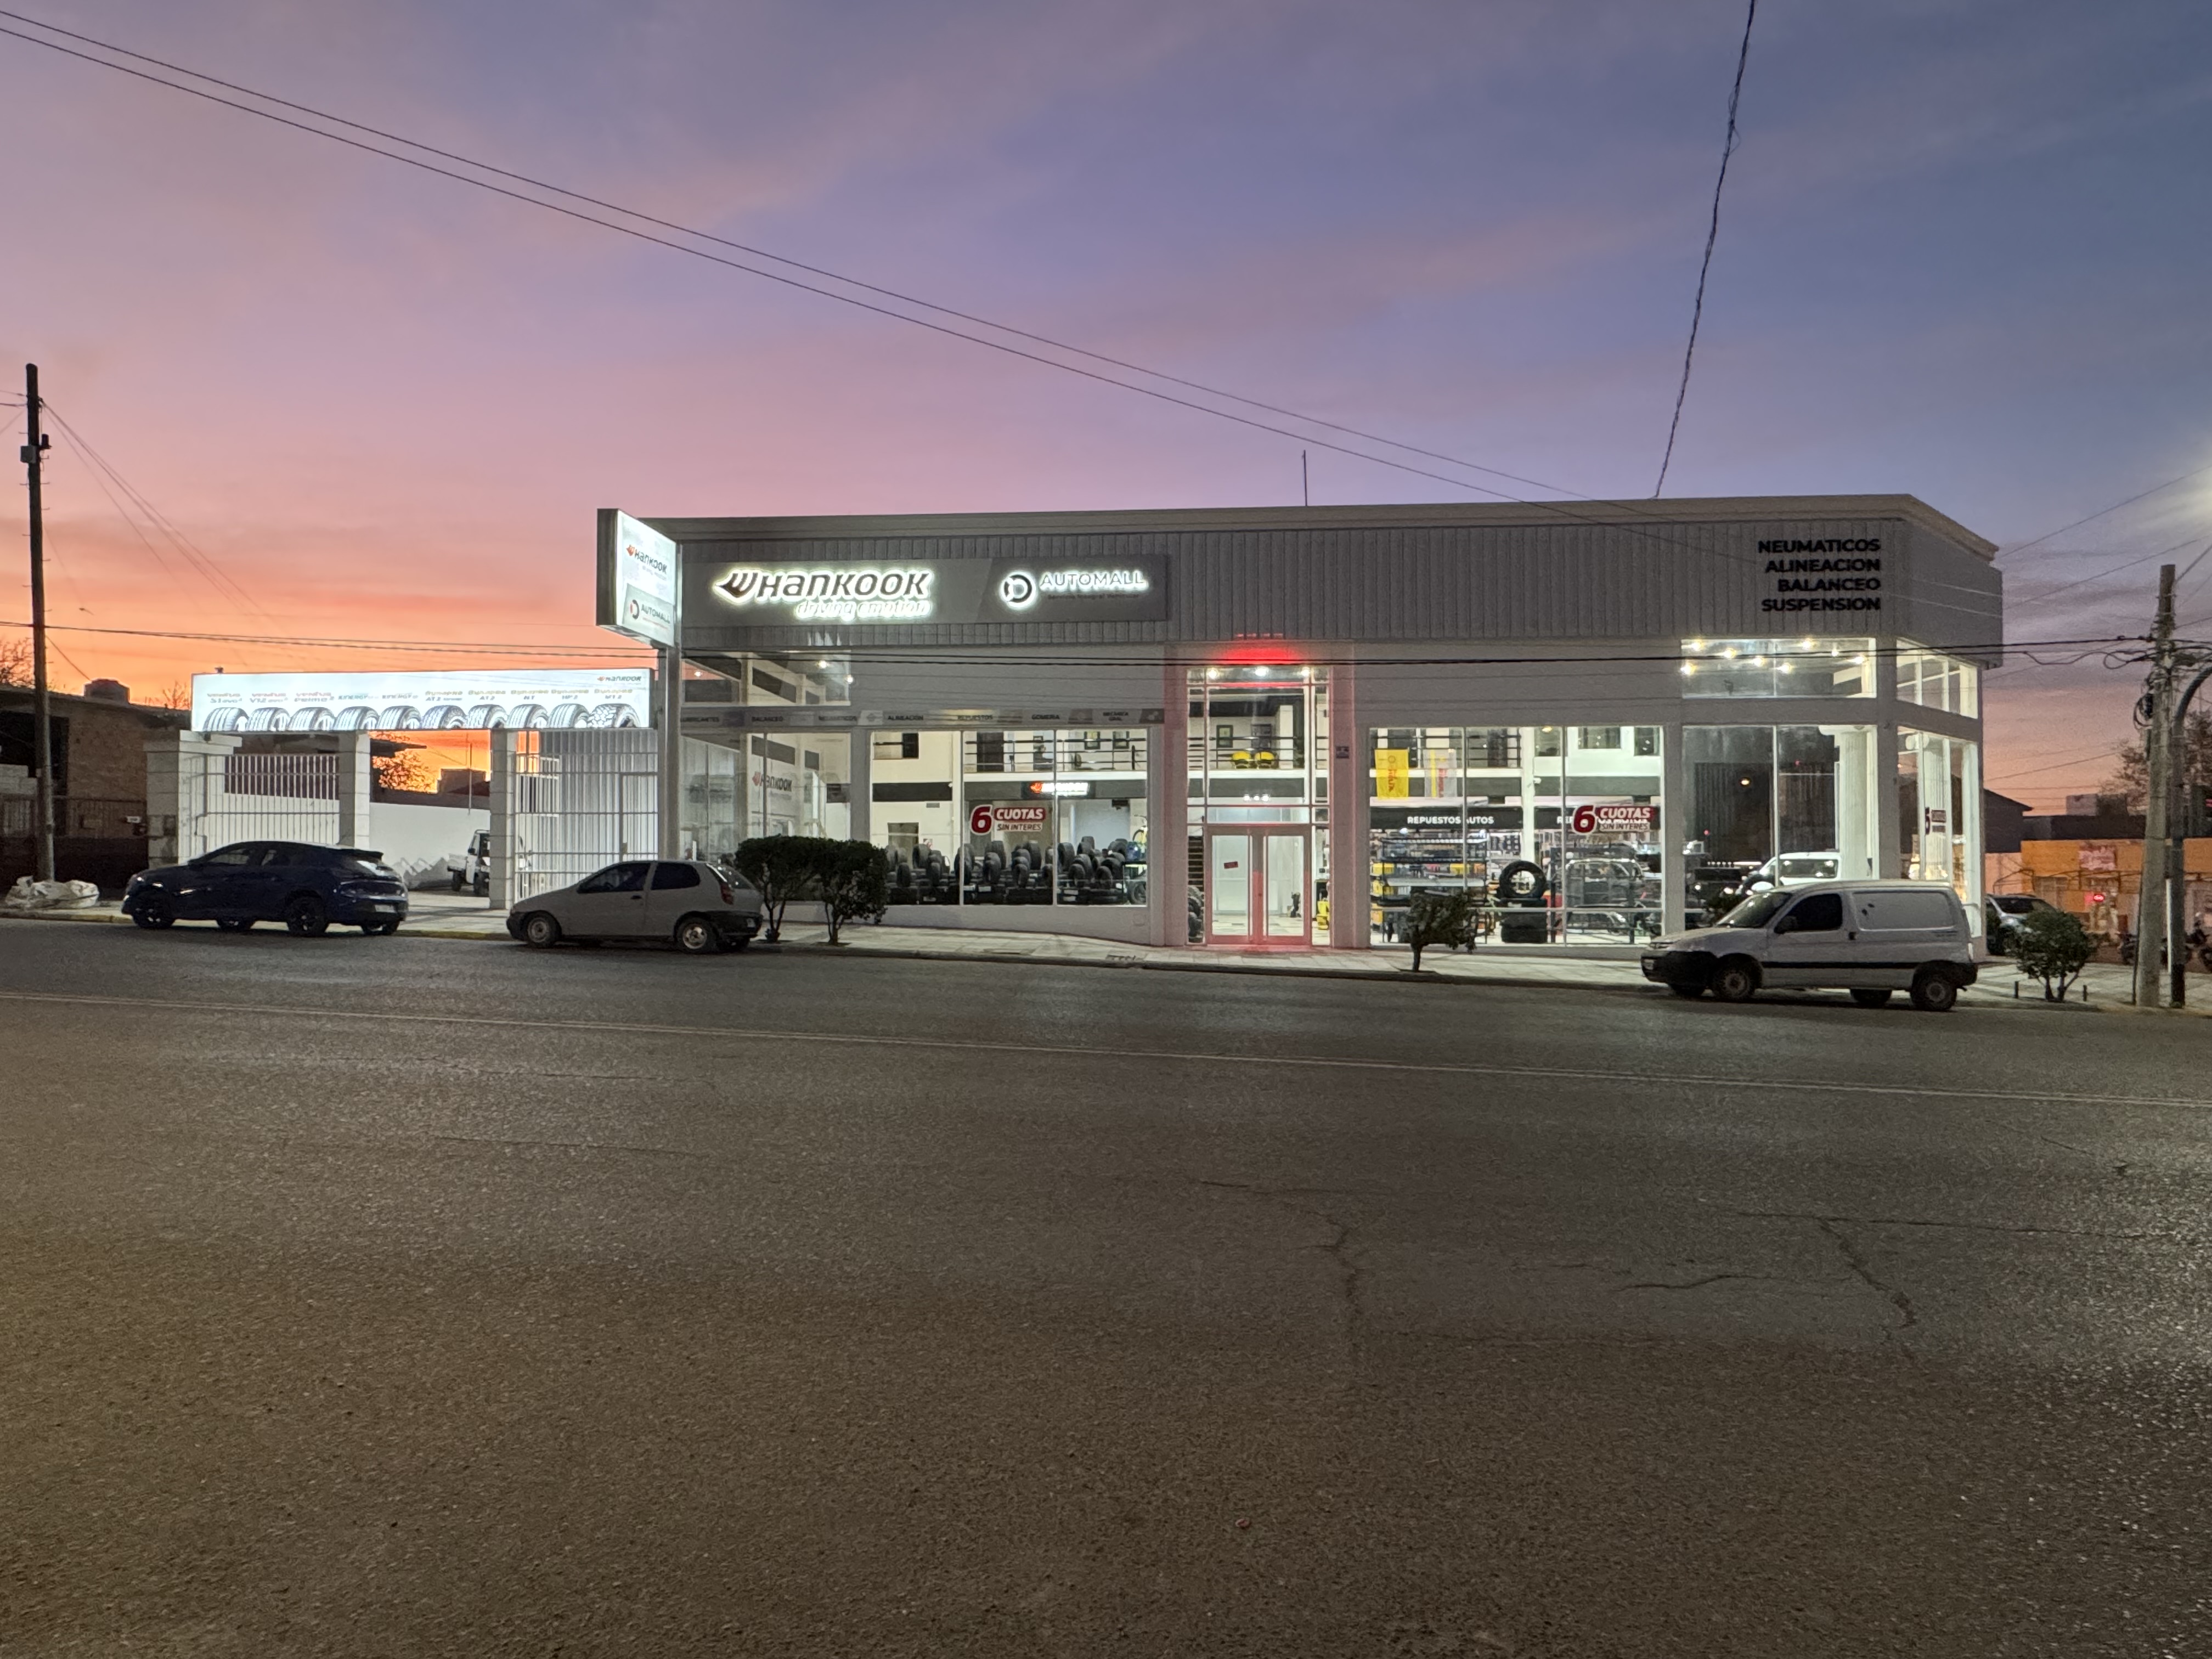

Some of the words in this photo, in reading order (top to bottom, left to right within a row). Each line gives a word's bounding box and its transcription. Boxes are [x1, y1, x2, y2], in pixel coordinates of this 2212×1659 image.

[1758, 539, 1881, 553] NEUMATICOS
[1765, 558, 1881, 573] ALINEACION
[1041, 571, 1146, 588] AUTOMALL
[1778, 578, 1881, 592] BALANCEO
[797, 600, 854, 620] driving
[857, 600, 929, 616] emotion
[1761, 597, 1881, 612] SUSPENSION
[641, 604, 670, 624] AUTOMALL
[970, 805, 992, 834] 6
[996, 809, 1043, 820] CUOTAS
[1407, 816, 1462, 824] REPUESTOS
[1573, 805, 1596, 833] 6
[1600, 808, 1650, 819] CUOTAS
